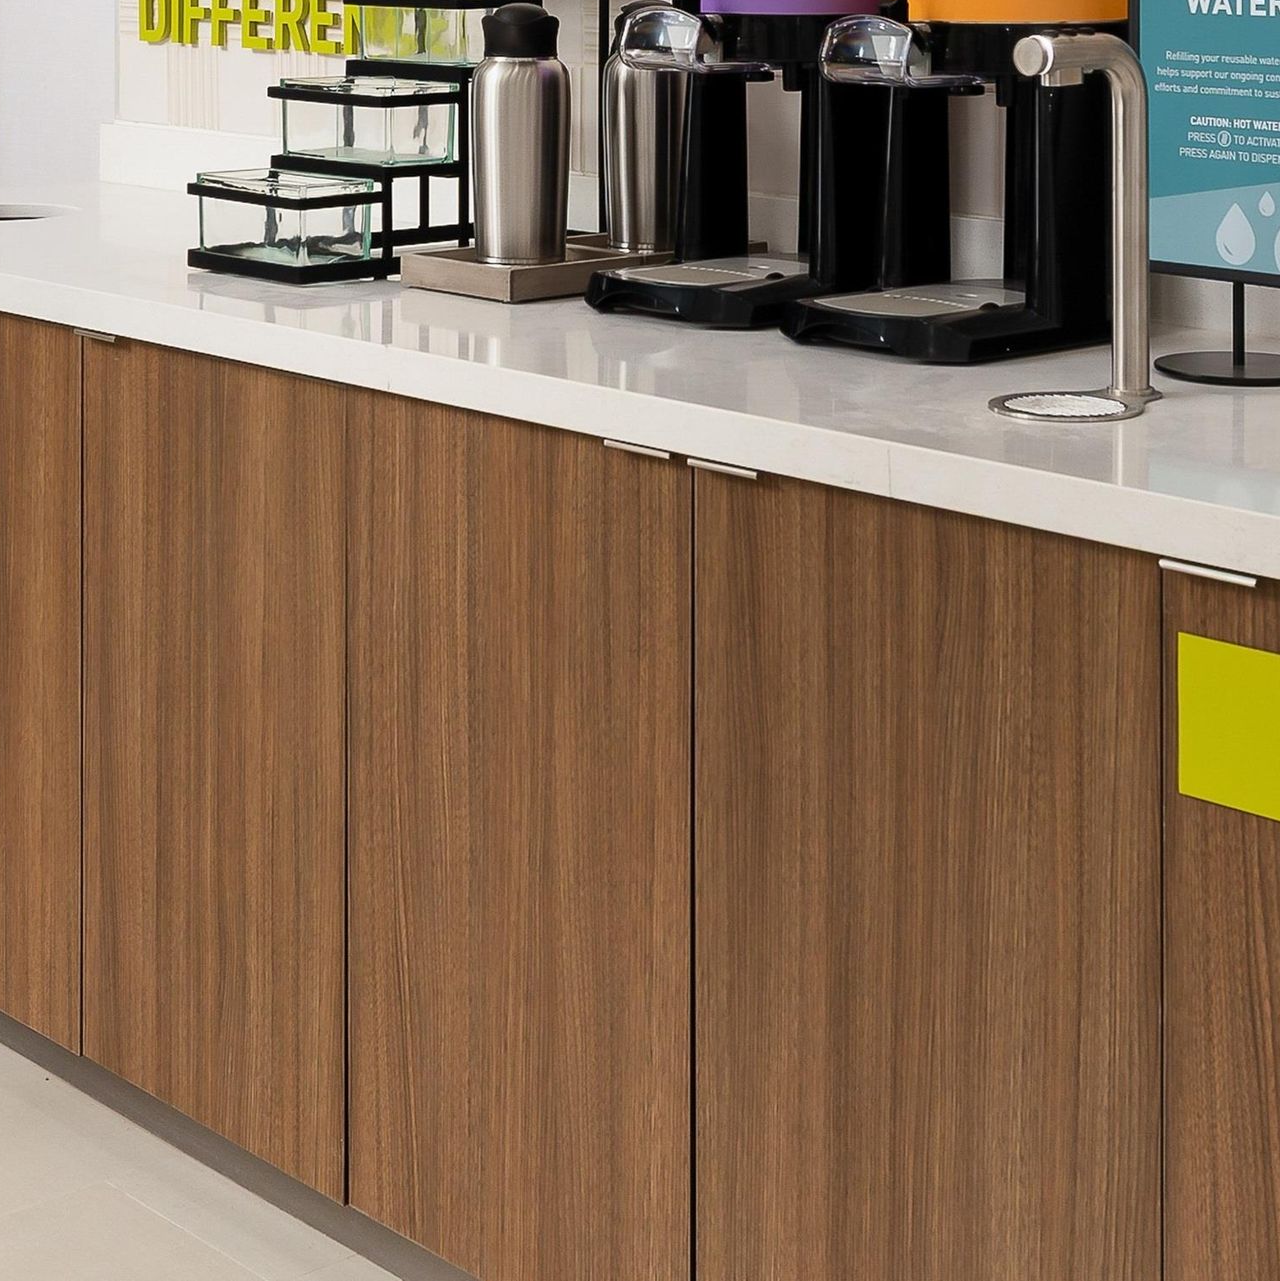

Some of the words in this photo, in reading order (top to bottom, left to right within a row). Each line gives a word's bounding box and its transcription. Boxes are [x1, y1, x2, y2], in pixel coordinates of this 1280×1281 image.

[1165, 51, 1200, 64] Refilling
[1201, 54, 1220, 64] your
[1221, 54, 1258, 65] reusable
[1156, 66, 1180, 77] helps
[1181, 68, 1212, 79] support
[1214, 71, 1228, 79] our
[1231, 71, 1264, 83] ongoing
[1154, 82, 1181, 93] efforts
[1182, 84, 1198, 94] and
[1200, 85, 1252, 97] commitment
[1254, 88, 1263, 97] to
[1190, 116, 1232, 128] CAUTION:
[1233, 119, 1252, 129] HOT
[1187, 131, 1216, 143] PRESS
[1233, 135, 1245, 146] TO
[1179, 147, 1207, 159] PRESS
[1209, 149, 1236, 161] AGAIN
[1238, 151, 1249, 162] TO
